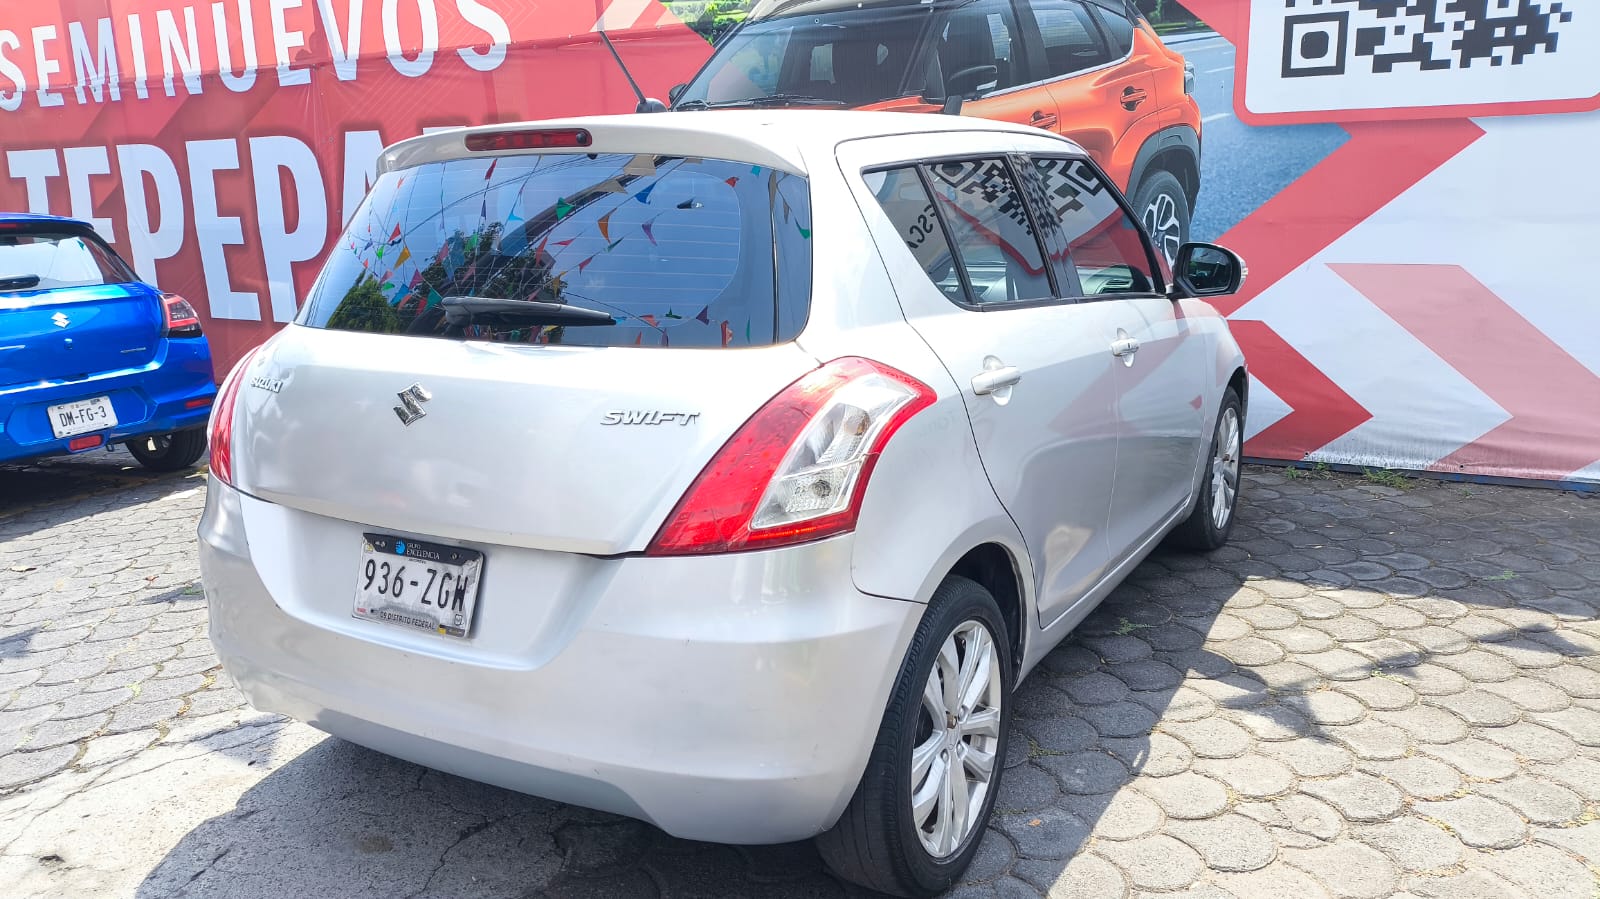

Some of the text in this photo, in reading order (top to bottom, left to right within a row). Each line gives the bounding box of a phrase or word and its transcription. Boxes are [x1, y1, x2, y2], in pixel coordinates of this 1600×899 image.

[0, 0, 511, 111] SEMINUEVOS
[59, 406, 107, 427] DM-FG-3
[600, 410, 700, 426] SWIFT
[406, 549, 440, 560] EXCELENCIA
[363, 559, 469, 612] 936-ZGW
